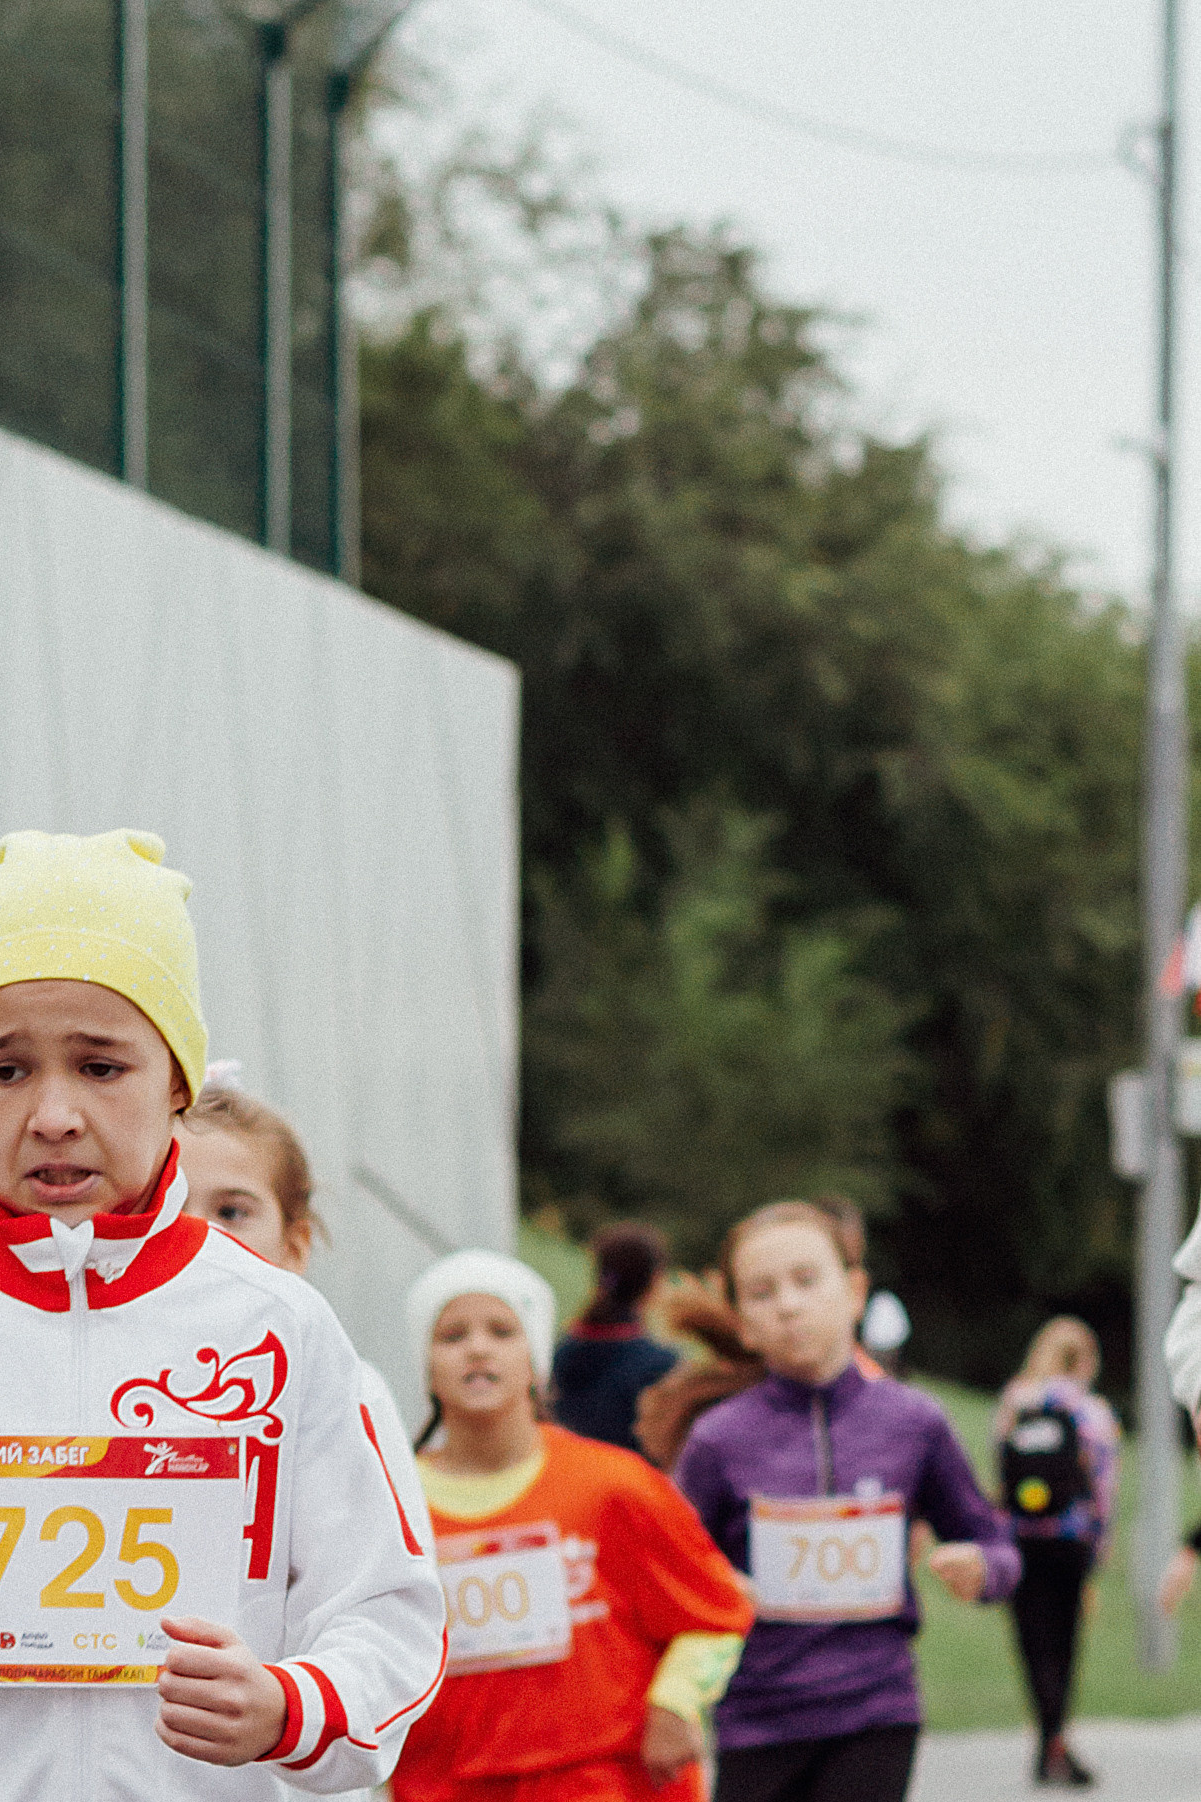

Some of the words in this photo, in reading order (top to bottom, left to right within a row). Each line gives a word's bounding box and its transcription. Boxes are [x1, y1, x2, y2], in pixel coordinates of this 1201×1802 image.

[27, 1445, 90, 1466] ЗАБЕГ
[784, 1534, 881, 1584] 700
[444, 1570, 530, 1629] 00
